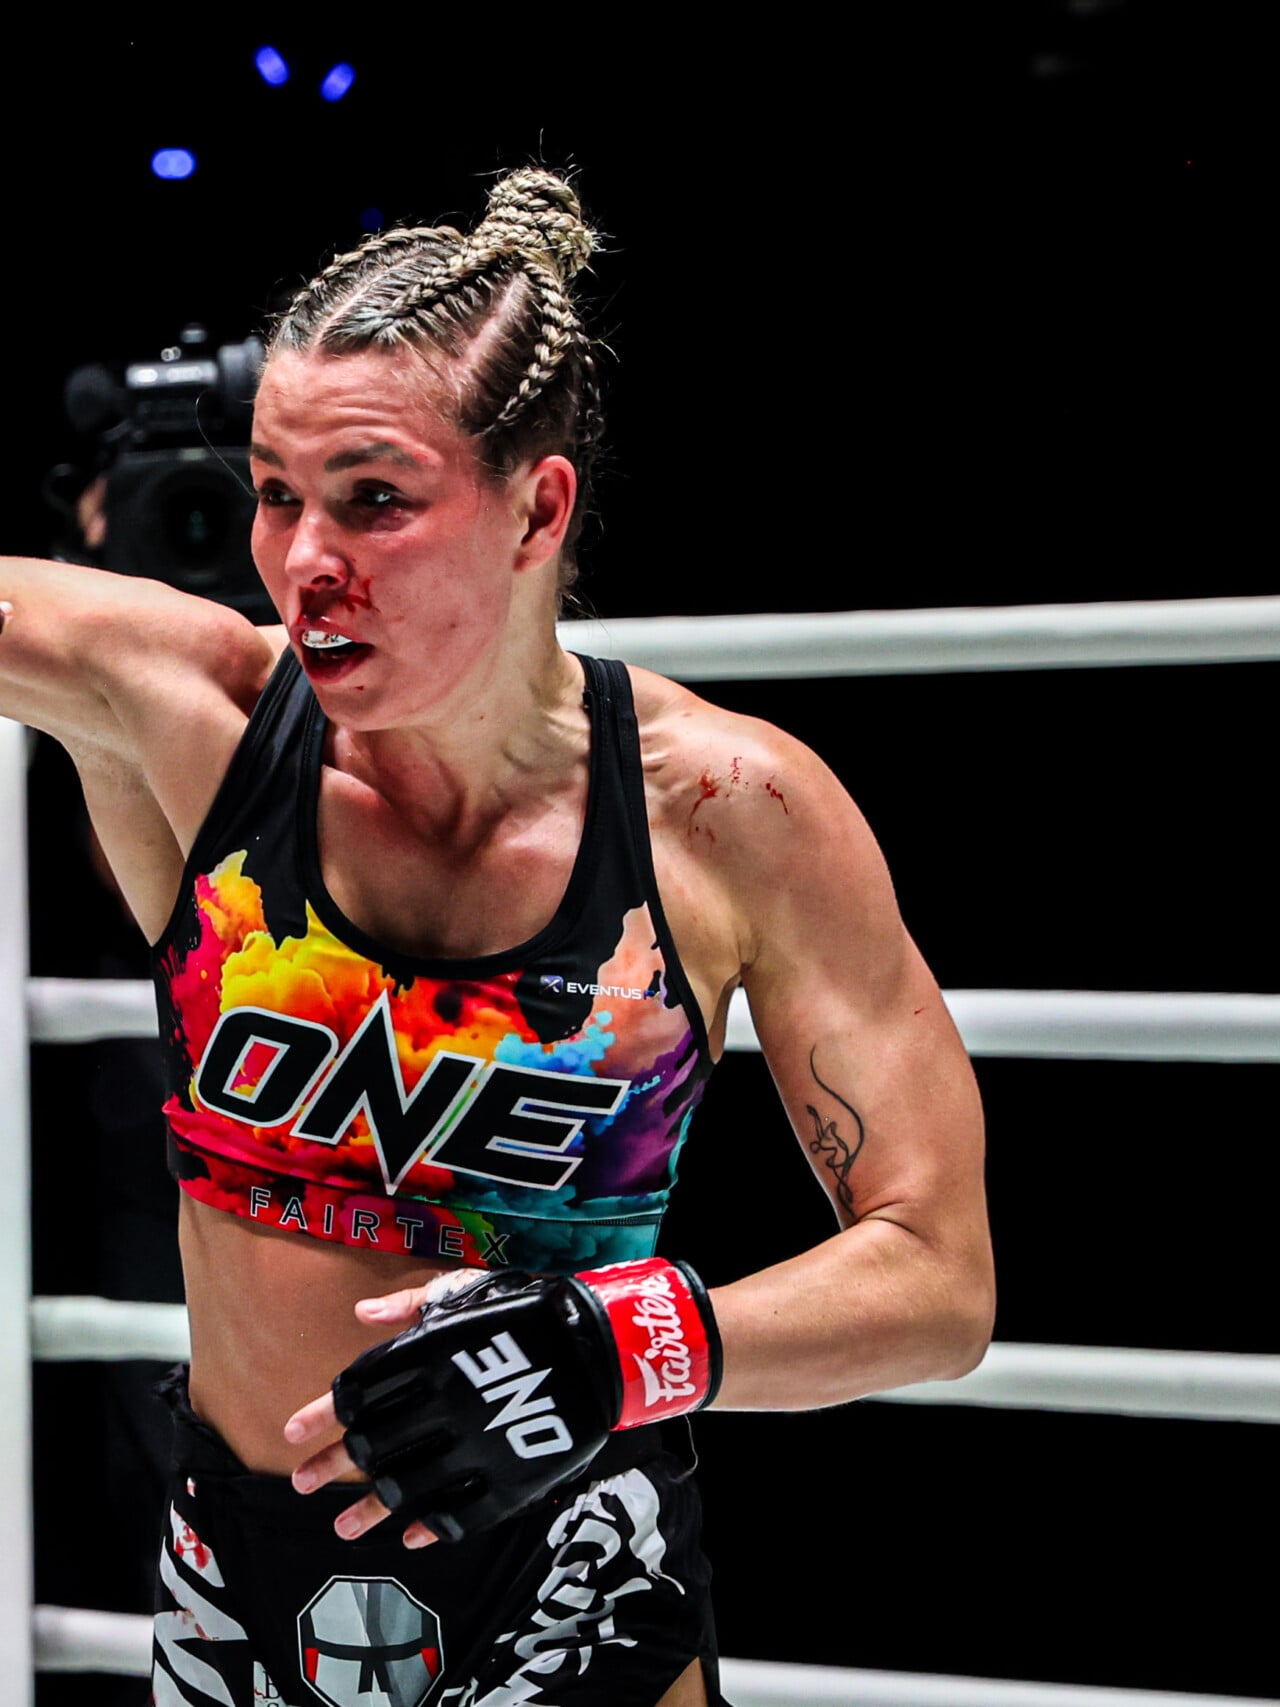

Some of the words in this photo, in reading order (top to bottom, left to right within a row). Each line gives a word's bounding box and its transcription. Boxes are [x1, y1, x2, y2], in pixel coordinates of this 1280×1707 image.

[566, 982, 642, 1000] EVENTUS
[195, 988, 632, 1196] ONE
[249, 1186, 511, 1266] FAIRTEX
[451, 1331, 574, 1460] ONE
[631, 1274, 697, 1408] Fairtex
